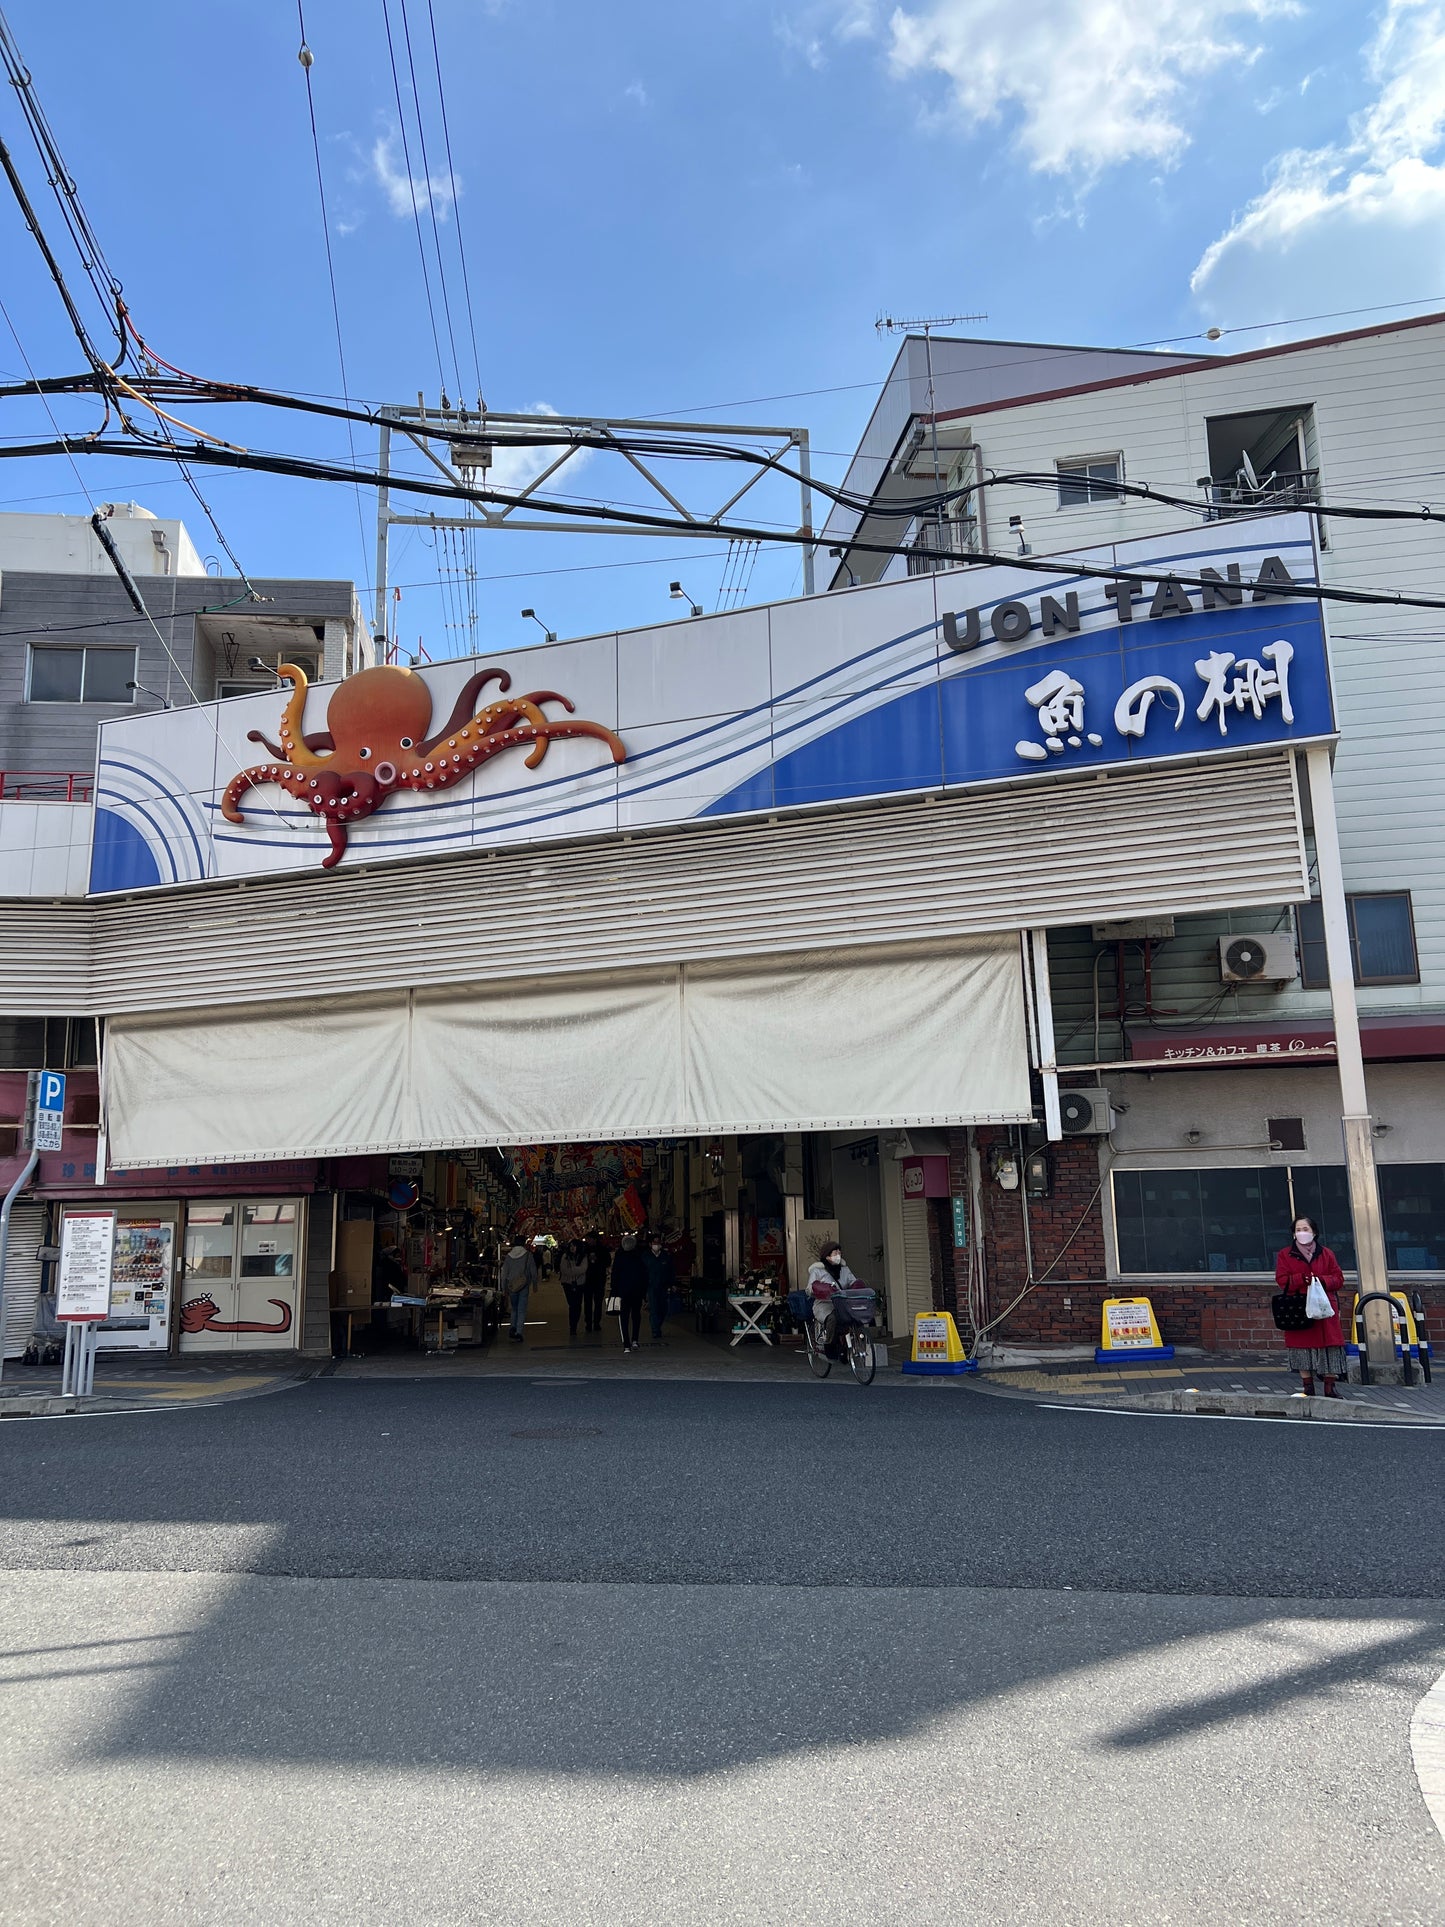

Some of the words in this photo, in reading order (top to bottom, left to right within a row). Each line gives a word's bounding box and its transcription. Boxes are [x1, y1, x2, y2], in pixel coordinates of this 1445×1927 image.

[942, 590, 1080, 651] UON
[1105, 555, 1296, 622] TANA
[1014, 639, 1295, 761] 魚の棚
[1164, 1045, 1248, 1059] キッチン&カフェ
[45, 1076, 61, 1106] P
[37, 1139, 60, 1149] ここから
[955, 1200, 963, 1246] 本町一丁目3
